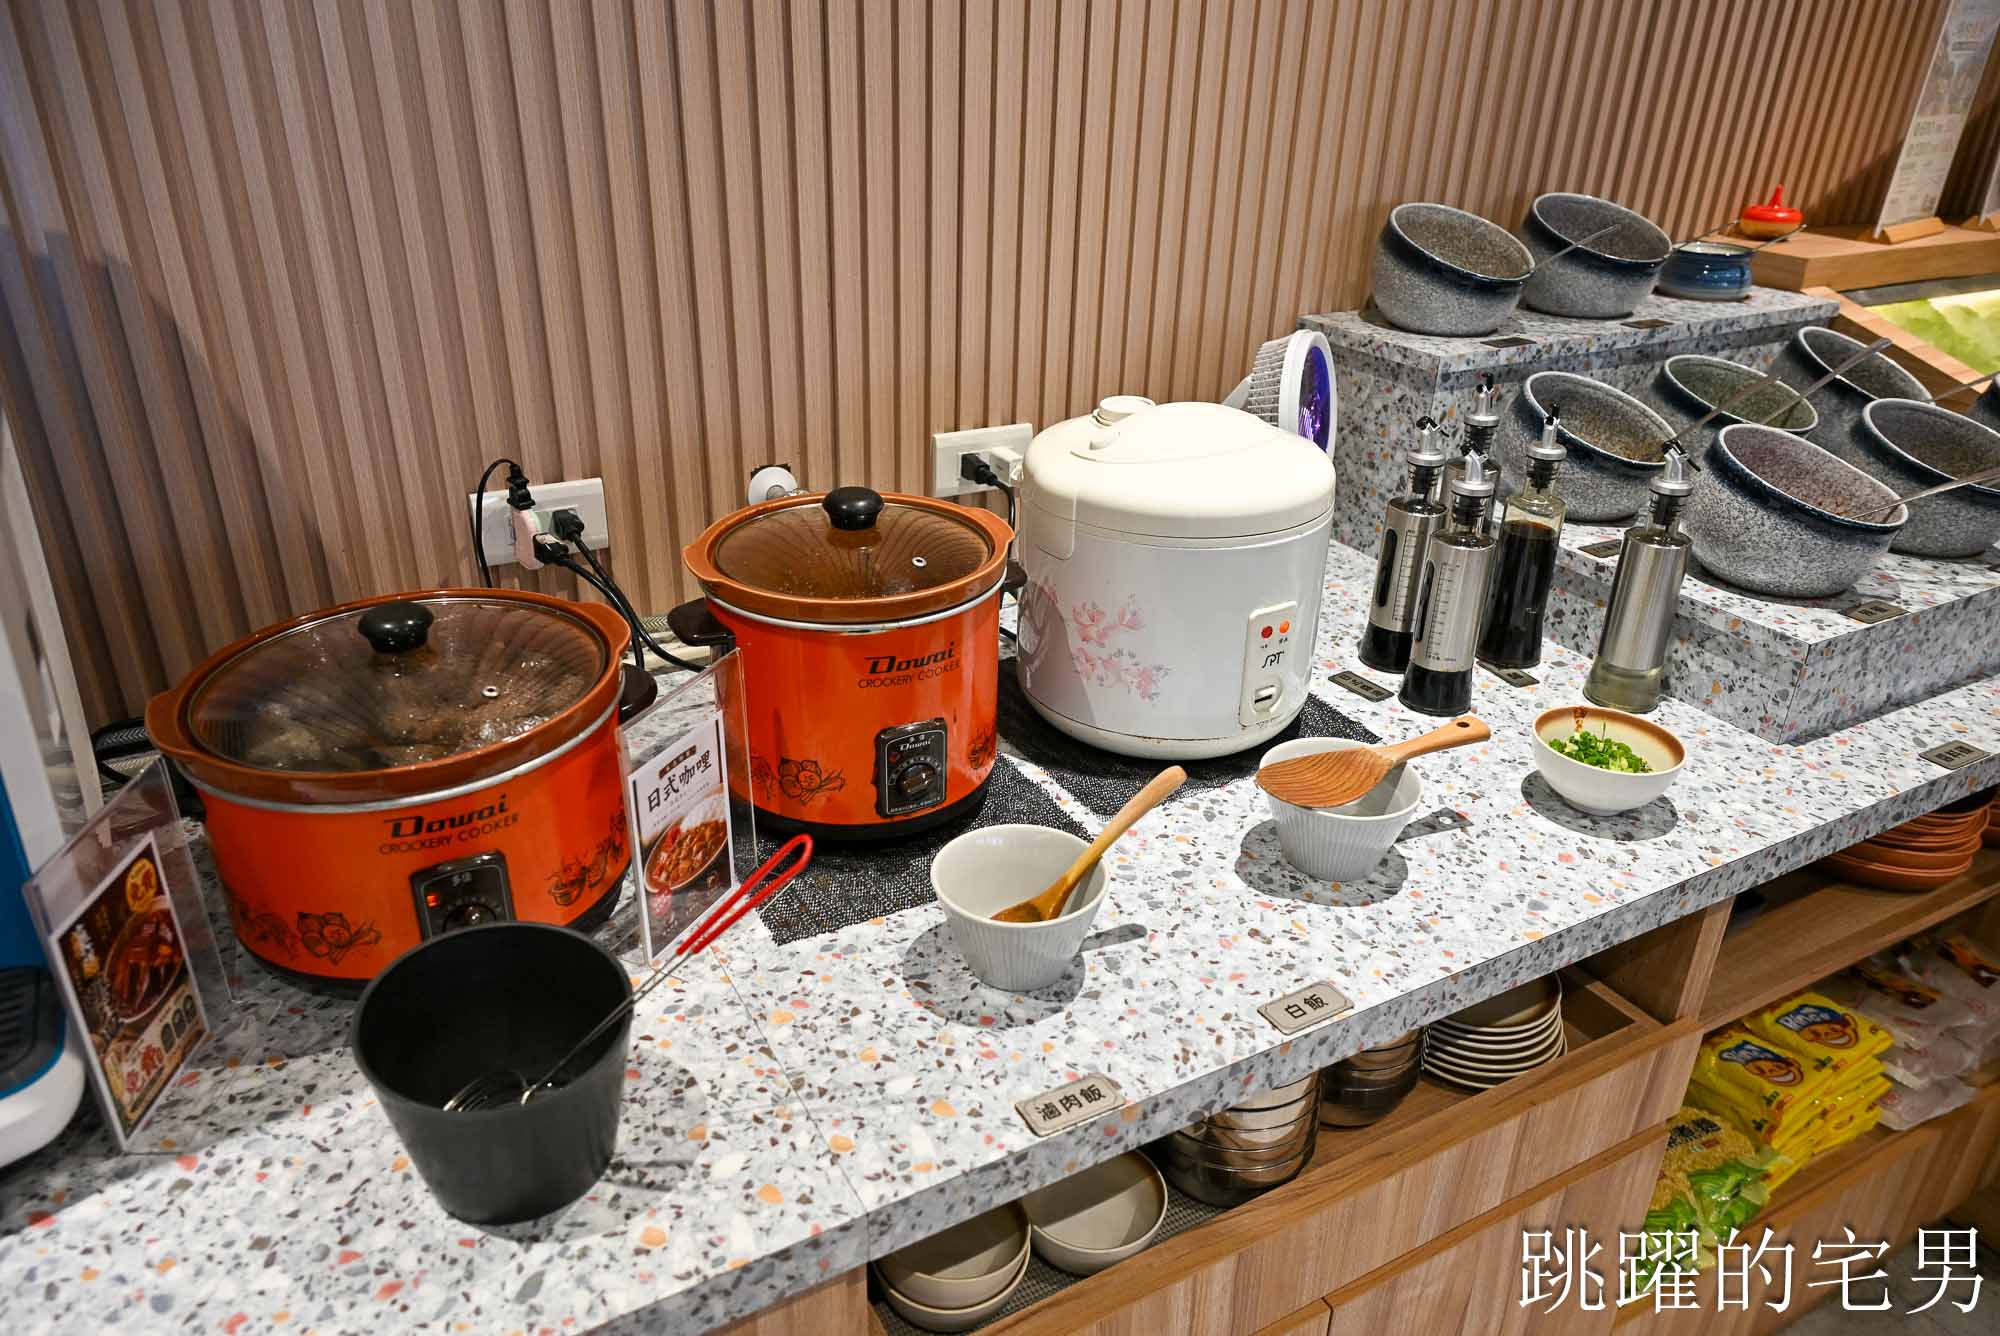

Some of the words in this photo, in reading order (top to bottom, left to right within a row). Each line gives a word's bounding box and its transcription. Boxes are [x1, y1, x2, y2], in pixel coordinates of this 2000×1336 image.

[857, 674, 913, 689] CROCKERY
[917, 659, 961, 681] COOKER
[864, 641, 955, 675] Dowai
[647, 749, 712, 812] 日式咖哩
[379, 834, 453, 855] CROCKERY
[457, 812, 519, 842] COOKER
[383, 793, 507, 838] Dowai
[1284, 993, 1329, 1019] 白飯
[1034, 1083, 1106, 1122] 滷肉飯
